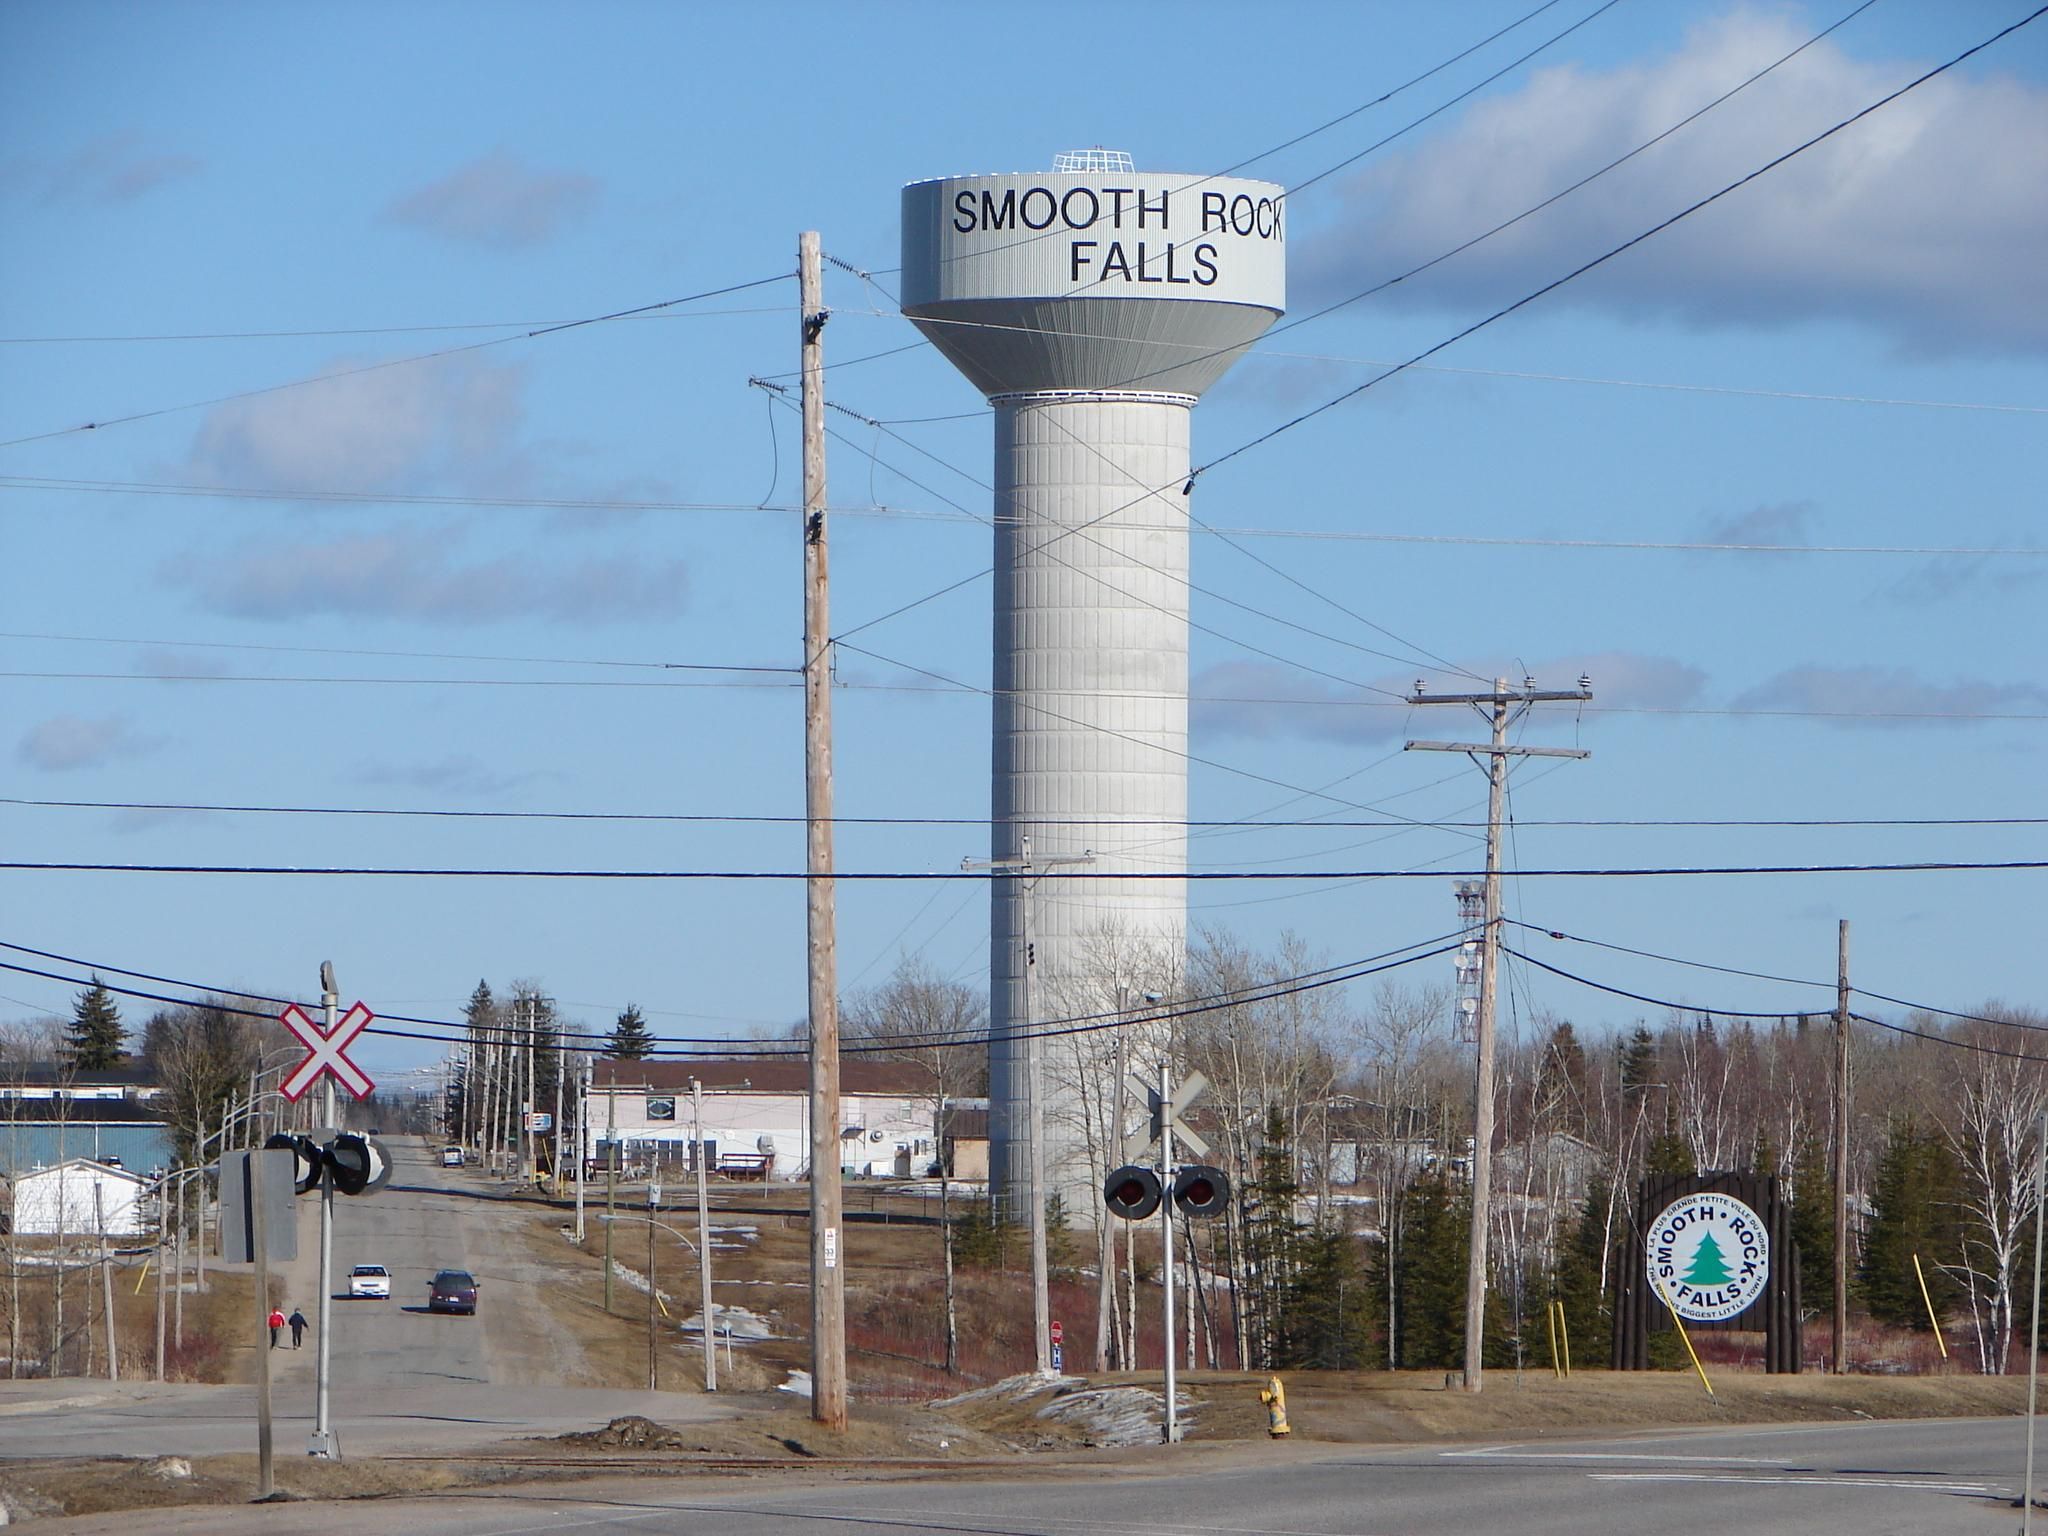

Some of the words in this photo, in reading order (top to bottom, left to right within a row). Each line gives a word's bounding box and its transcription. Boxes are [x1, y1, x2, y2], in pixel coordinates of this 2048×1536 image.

[953, 188, 1169, 233] SMOOTH
[1202, 191, 1283, 243] ROCK
[1071, 241, 1219, 286] FALLS
[1648, 1238, 1656, 1248] LA
[1652, 1216, 1667, 1236] PLUS
[1666, 1197, 1698, 1217] GRANDE
[1700, 1195, 1728, 1206] PETITE
[1730, 1202, 1751, 1219] VILLE
[1749, 1219, 1760, 1231] DU
[1756, 1231, 1766, 1255] NORD
[1657, 1206, 1714, 1278] SMOOTH
[1729, 1217, 1759, 1279] ROCK
[1649, 1265, 1657, 1282] THE
[1681, 1307, 1717, 1318] BIGGEST
[1718, 1299, 1745, 1317] LITTLE
[1747, 1275, 1763, 1298] TOWN
[1677, 1284, 1741, 1308] FALLS
